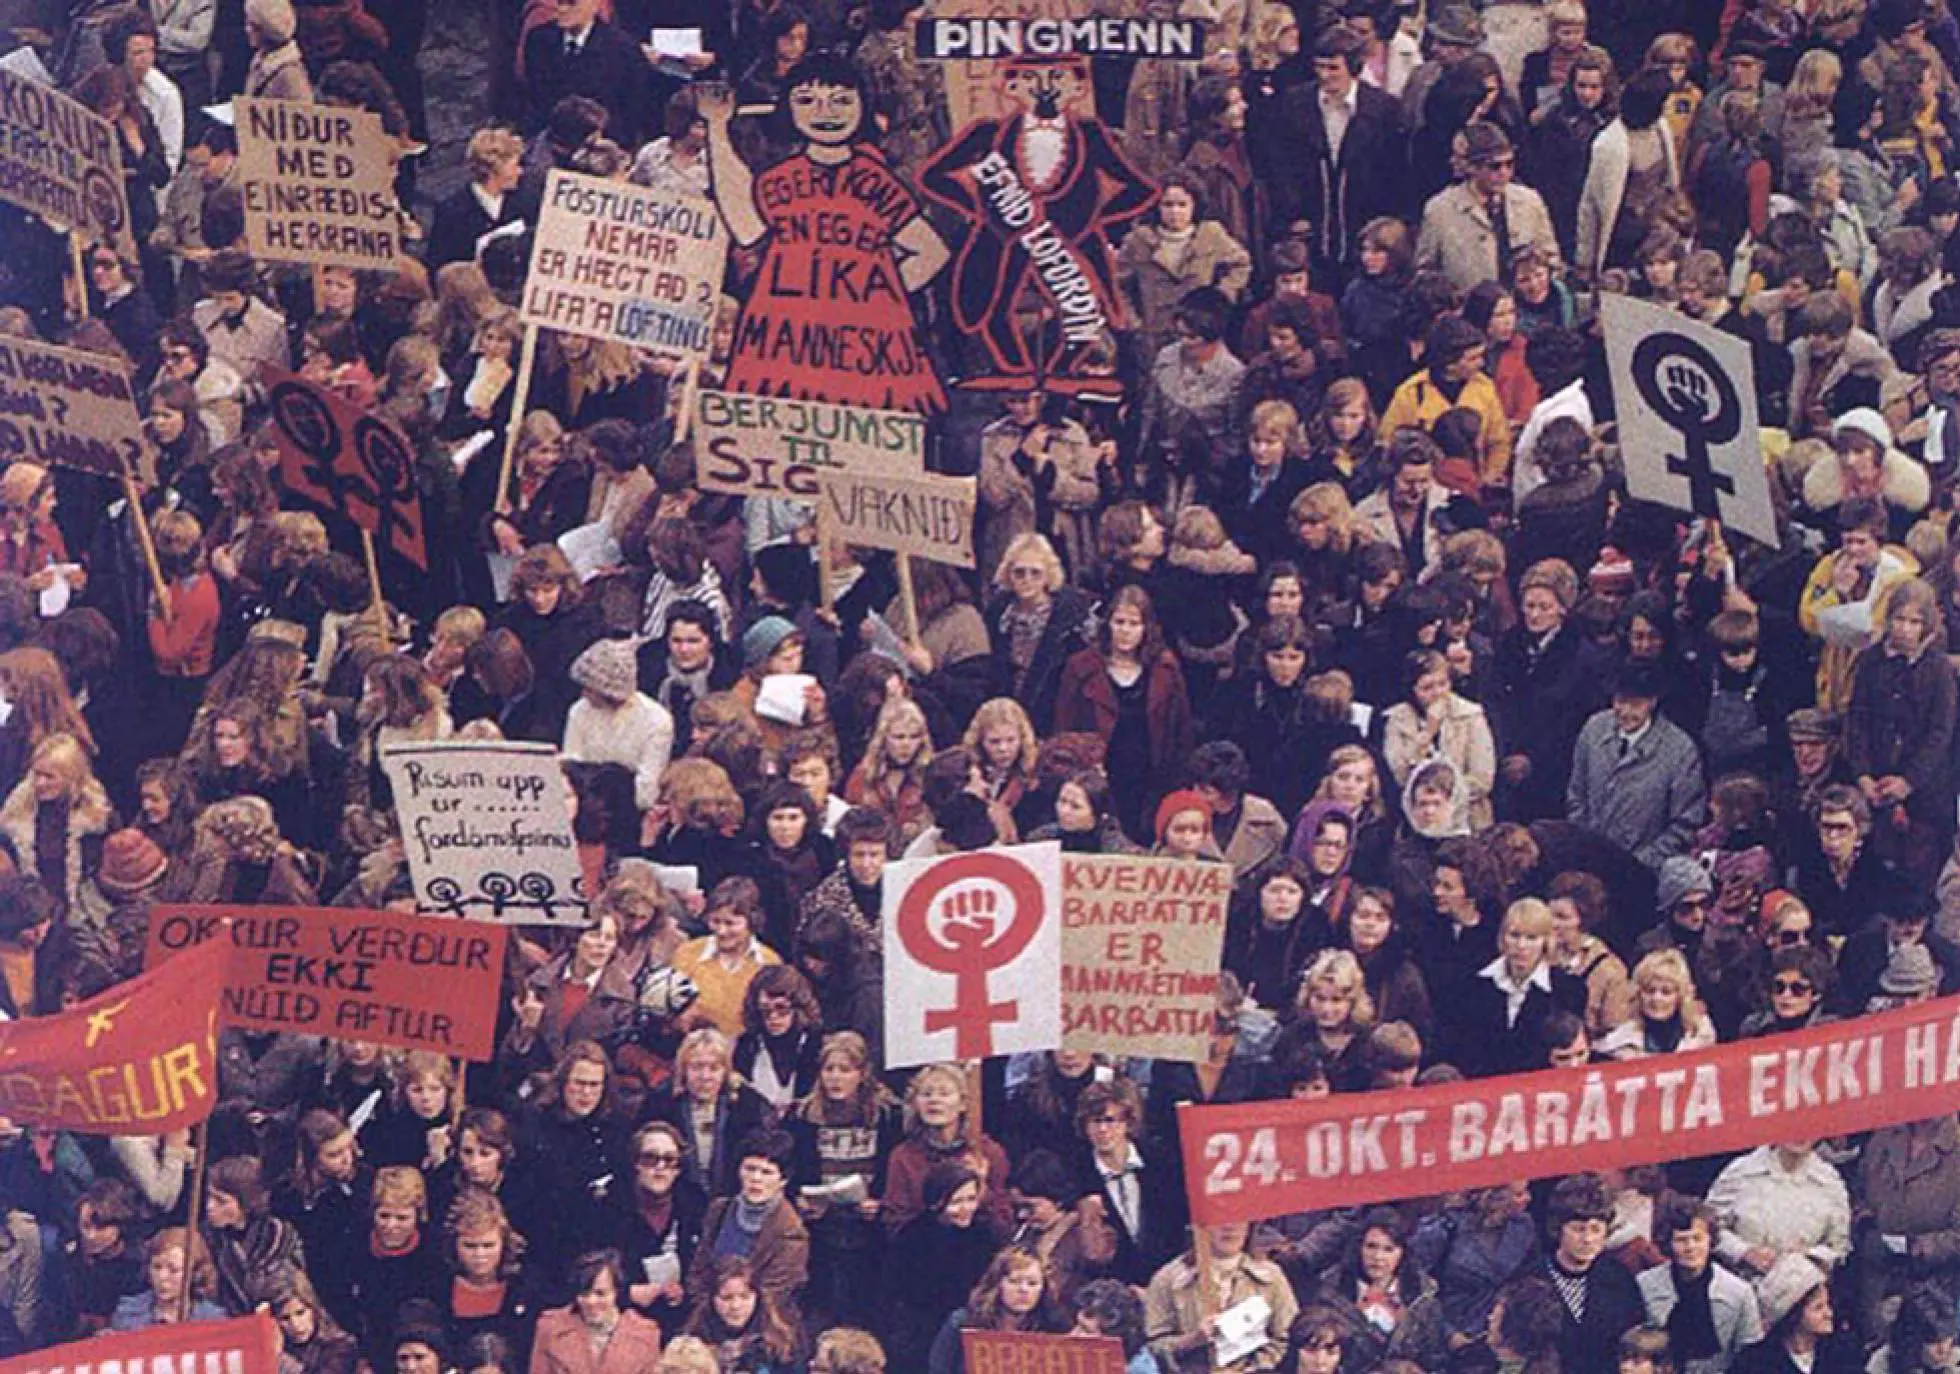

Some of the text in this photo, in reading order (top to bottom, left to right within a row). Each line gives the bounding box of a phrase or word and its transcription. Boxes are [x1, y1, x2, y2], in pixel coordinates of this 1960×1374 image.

[585, 220, 679, 264] NEMAR
[537, 249, 567, 278] ER
[496, 774, 545, 801] upp
[1107, 931, 1168, 966] ER
[267, 952, 376, 993] EKKI
[1204, 1128, 1297, 1196] 24.
[1306, 1110, 1438, 1179] OKT.
[1449, 1063, 1724, 1163] BARÁTTA
[1750, 1036, 1884, 1118] EKKI
